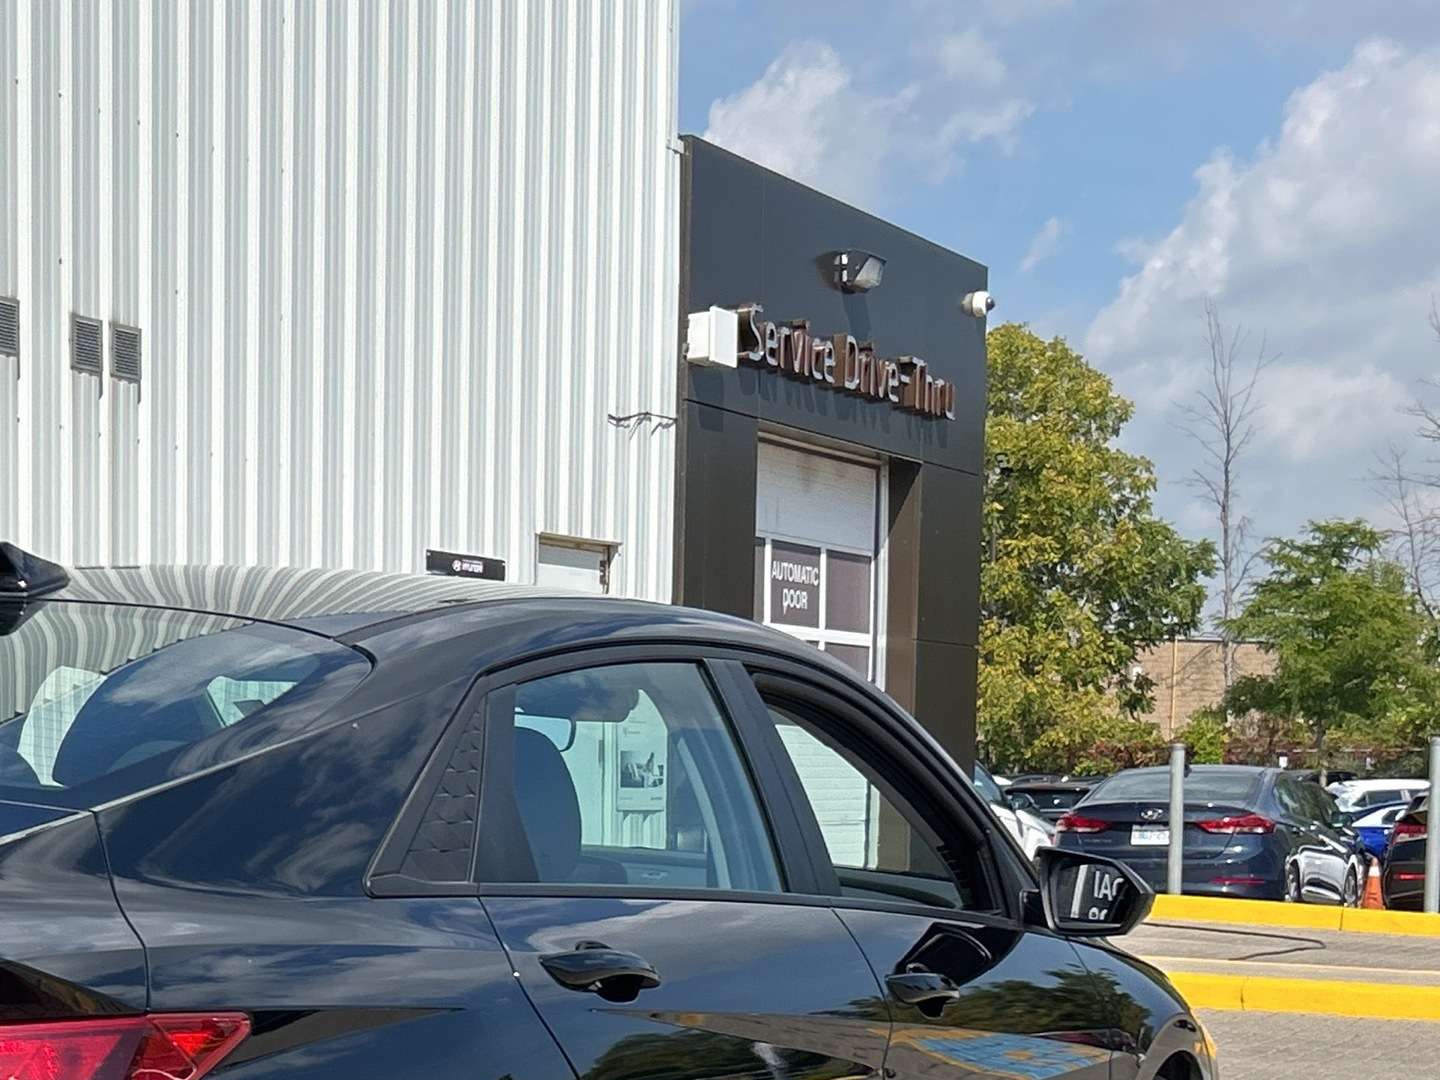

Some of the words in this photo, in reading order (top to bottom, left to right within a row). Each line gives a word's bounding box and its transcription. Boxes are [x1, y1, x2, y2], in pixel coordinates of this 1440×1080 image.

[747, 303, 836, 384] Service
[771, 560, 819, 586] AUTOMATIC
[782, 588, 808, 610] DOOR
